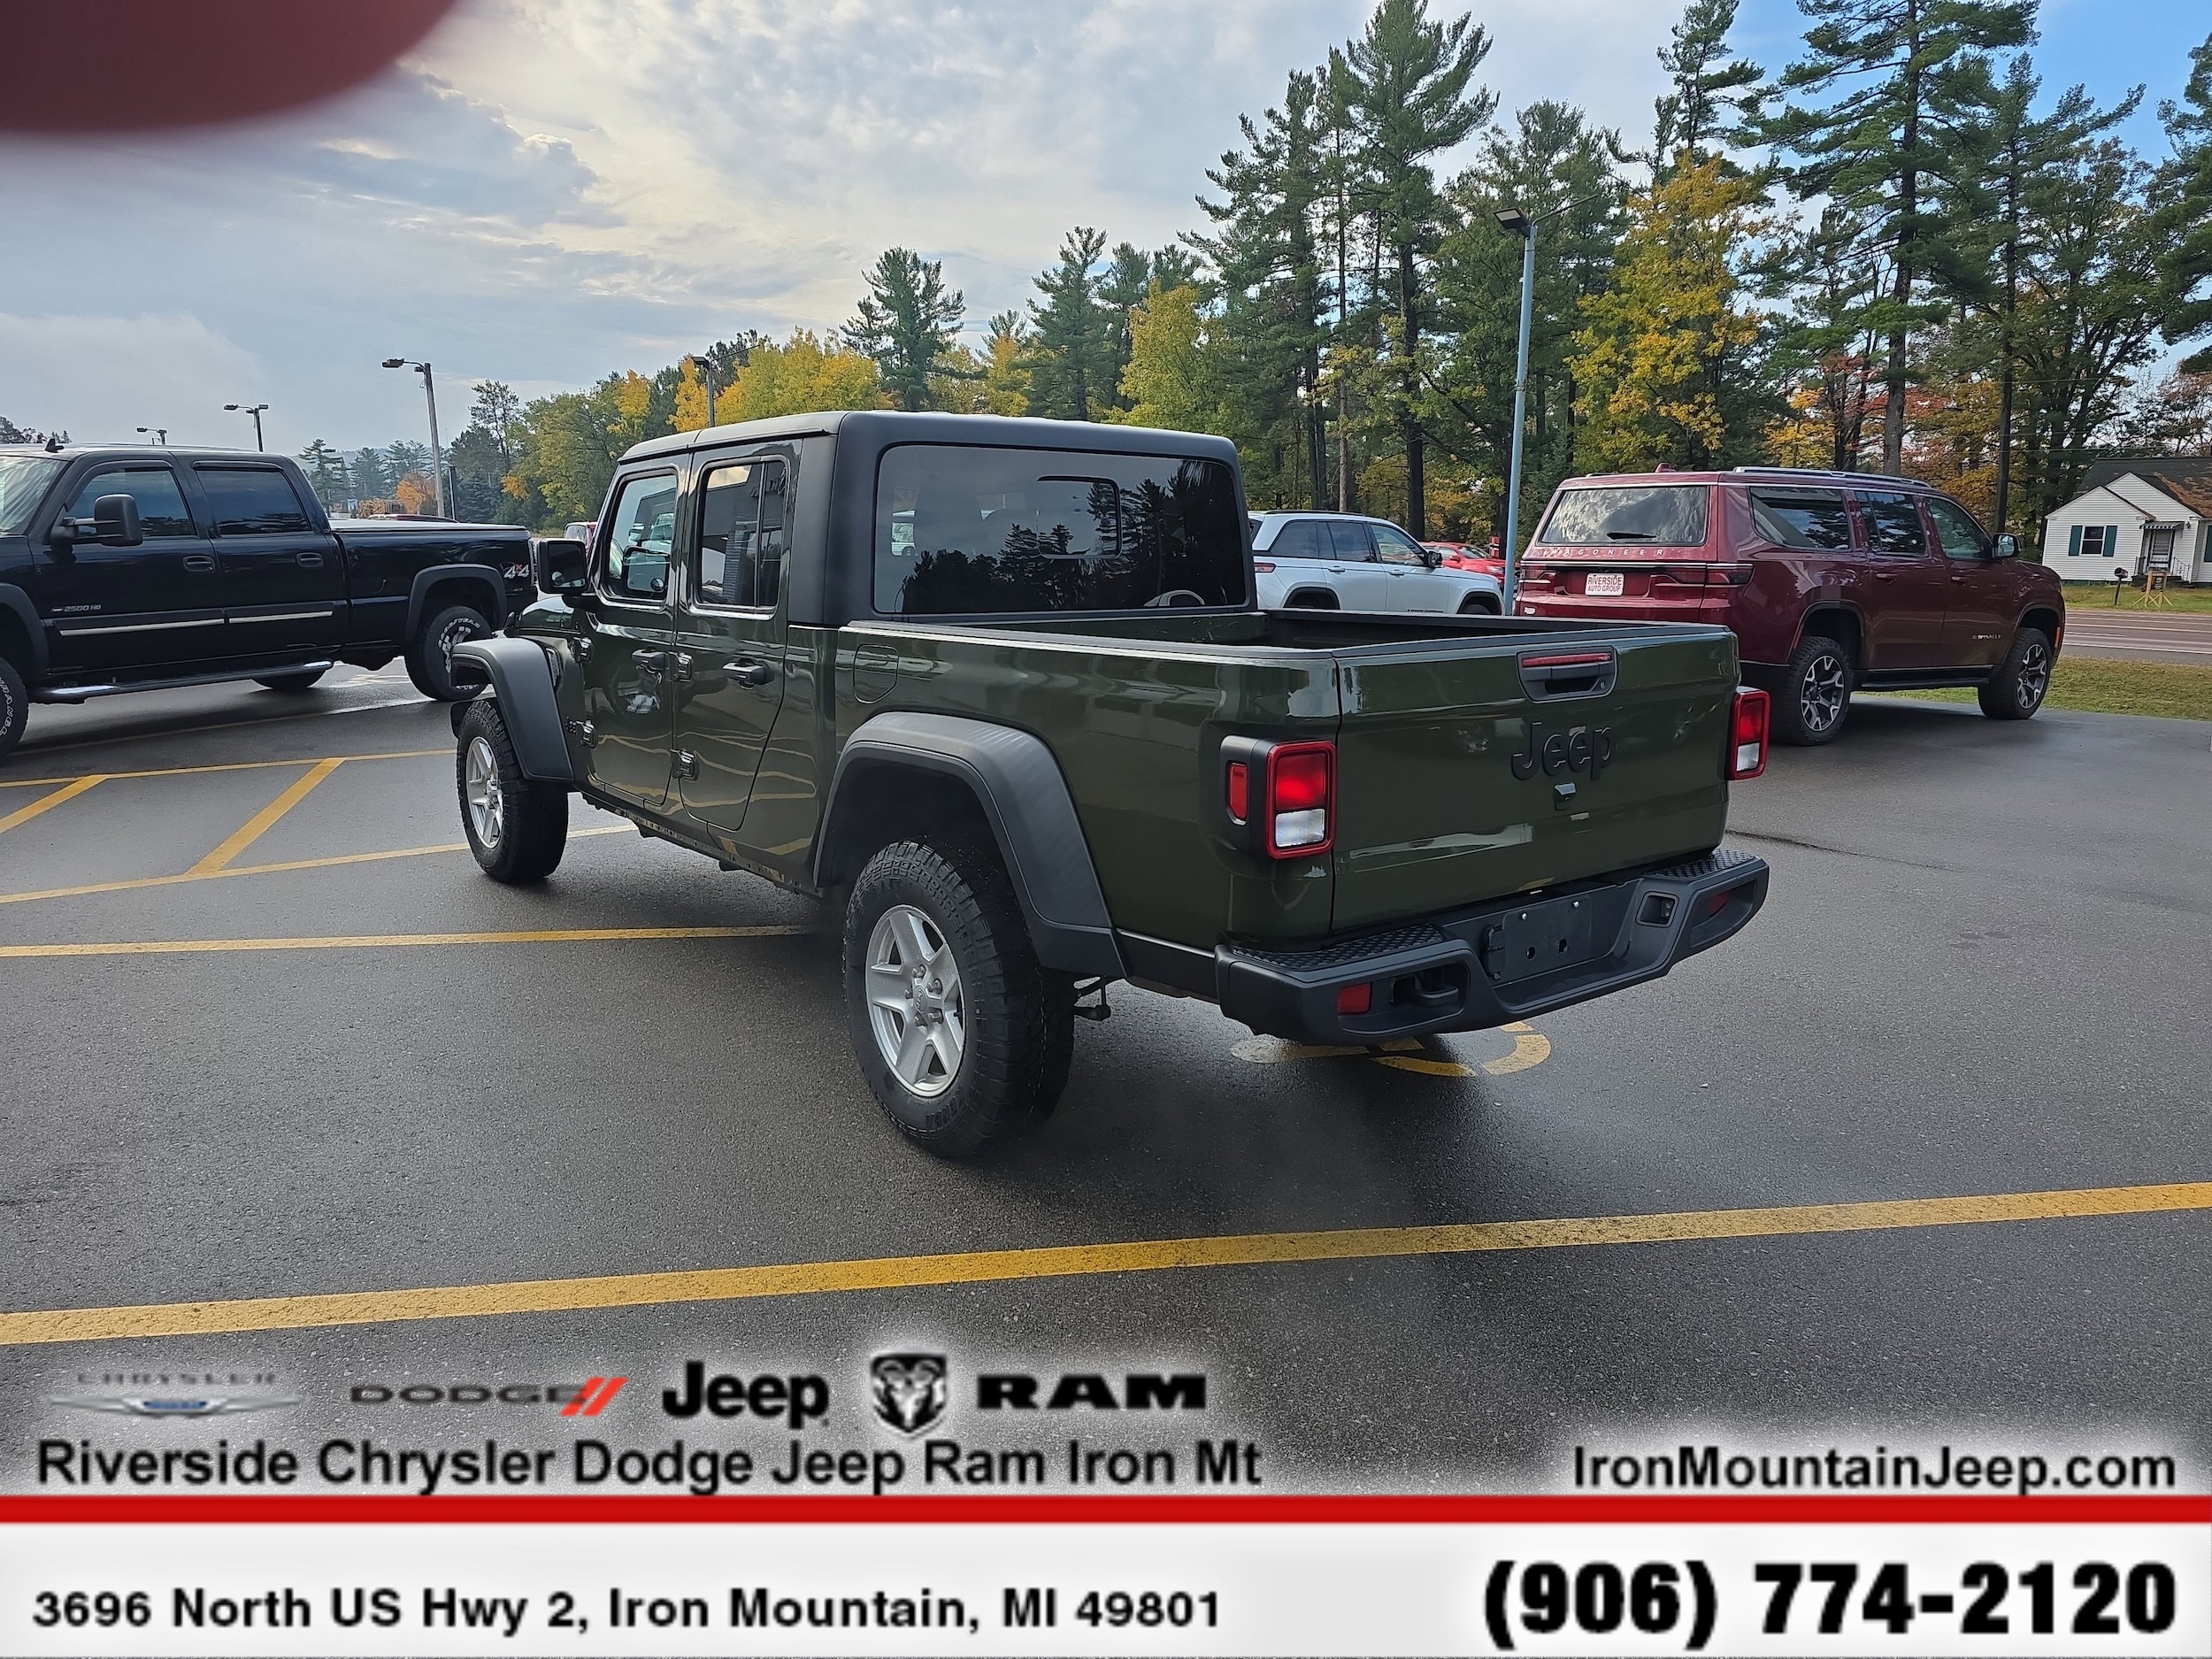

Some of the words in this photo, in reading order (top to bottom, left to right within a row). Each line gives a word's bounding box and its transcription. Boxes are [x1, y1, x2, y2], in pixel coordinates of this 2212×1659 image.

[1551, 548, 1665, 557] WAGONEER
[1587, 576, 1623, 586] RIVERSIDE
[1510, 721, 1612, 780] Jeep
